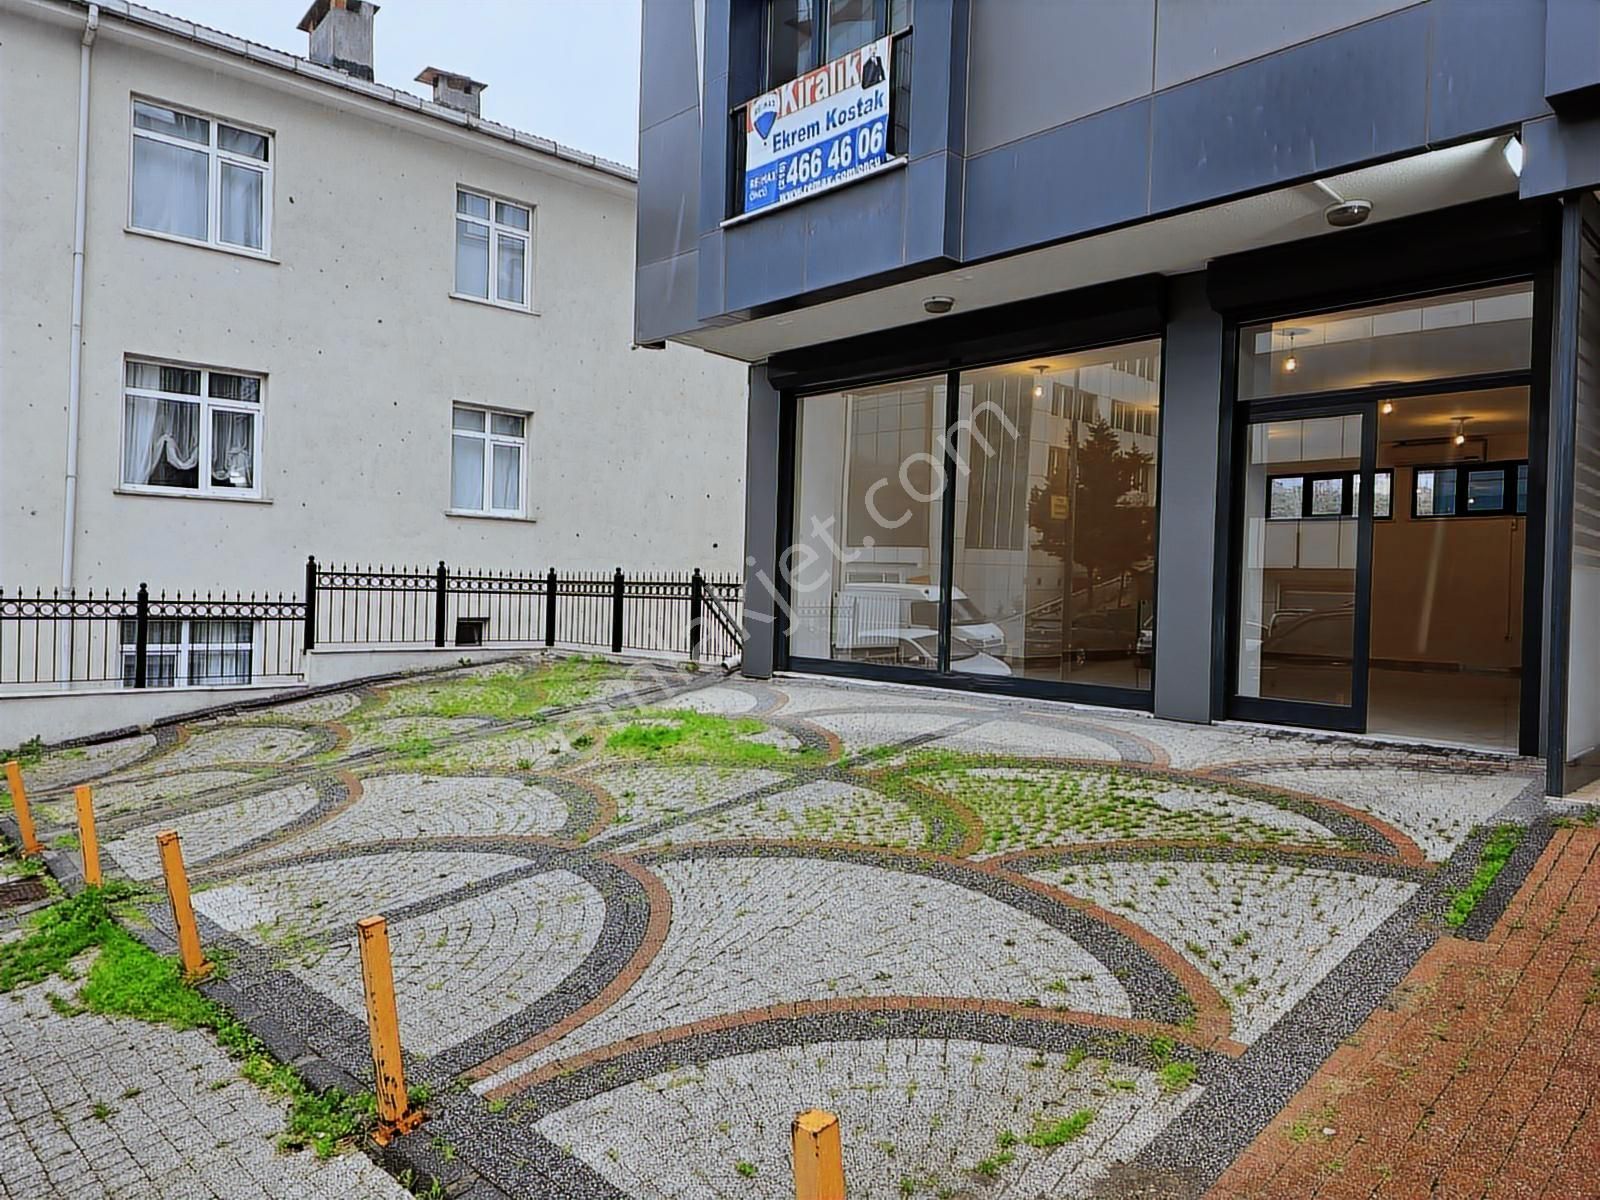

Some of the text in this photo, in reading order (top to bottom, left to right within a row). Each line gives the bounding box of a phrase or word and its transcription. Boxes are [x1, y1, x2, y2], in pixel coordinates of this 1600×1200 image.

[772, 90, 885, 153] Ekrem Kostak
[786, 122, 883, 186] 466 46 06
